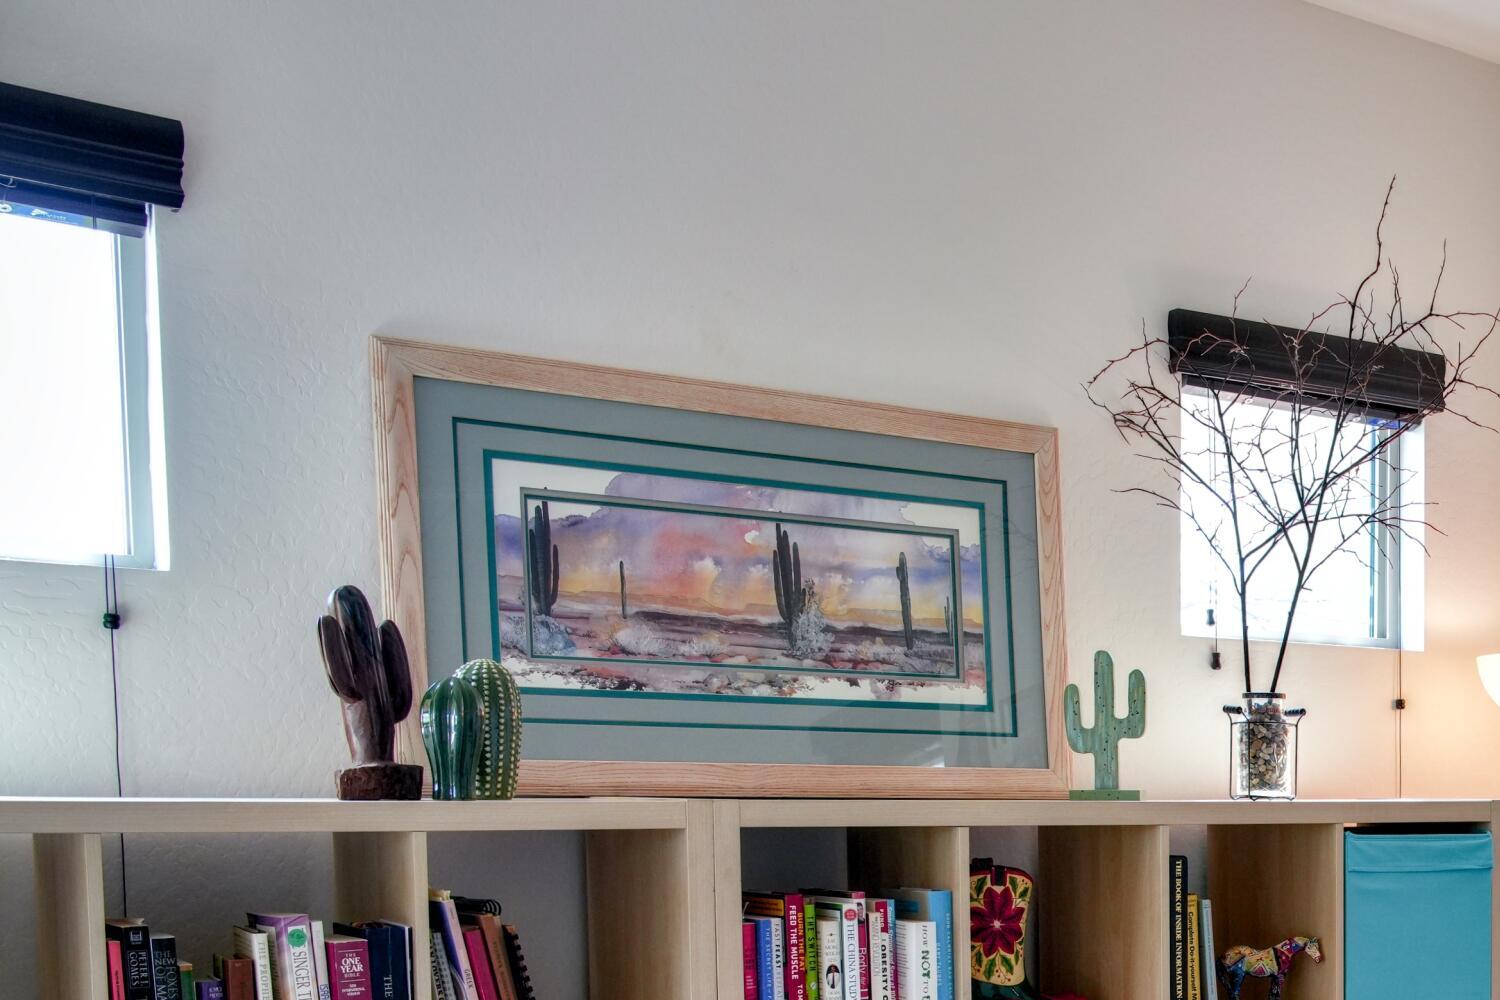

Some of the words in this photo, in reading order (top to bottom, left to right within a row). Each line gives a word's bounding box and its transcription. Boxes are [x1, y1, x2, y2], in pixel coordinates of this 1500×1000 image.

[1176, 902, 1182, 912] OF
[807, 916, 815, 932] THE
[846, 924, 855, 942] THE
[790, 928, 798, 943] THE
[138, 951, 148, 977] PETER
[342, 958, 360, 966] ONE
[791, 945, 799, 980] MUSCLE
[798, 954, 806, 972] FAT
[808, 936, 816, 972] SWITCH
[848, 942, 856, 972] CHINA
[921, 950, 931, 979] NOT
[129, 952, 140, 986] GOMES
[293, 951, 308, 990] SINGER
[340, 964, 364, 972] YEAR
[384, 975, 393, 996] THE
